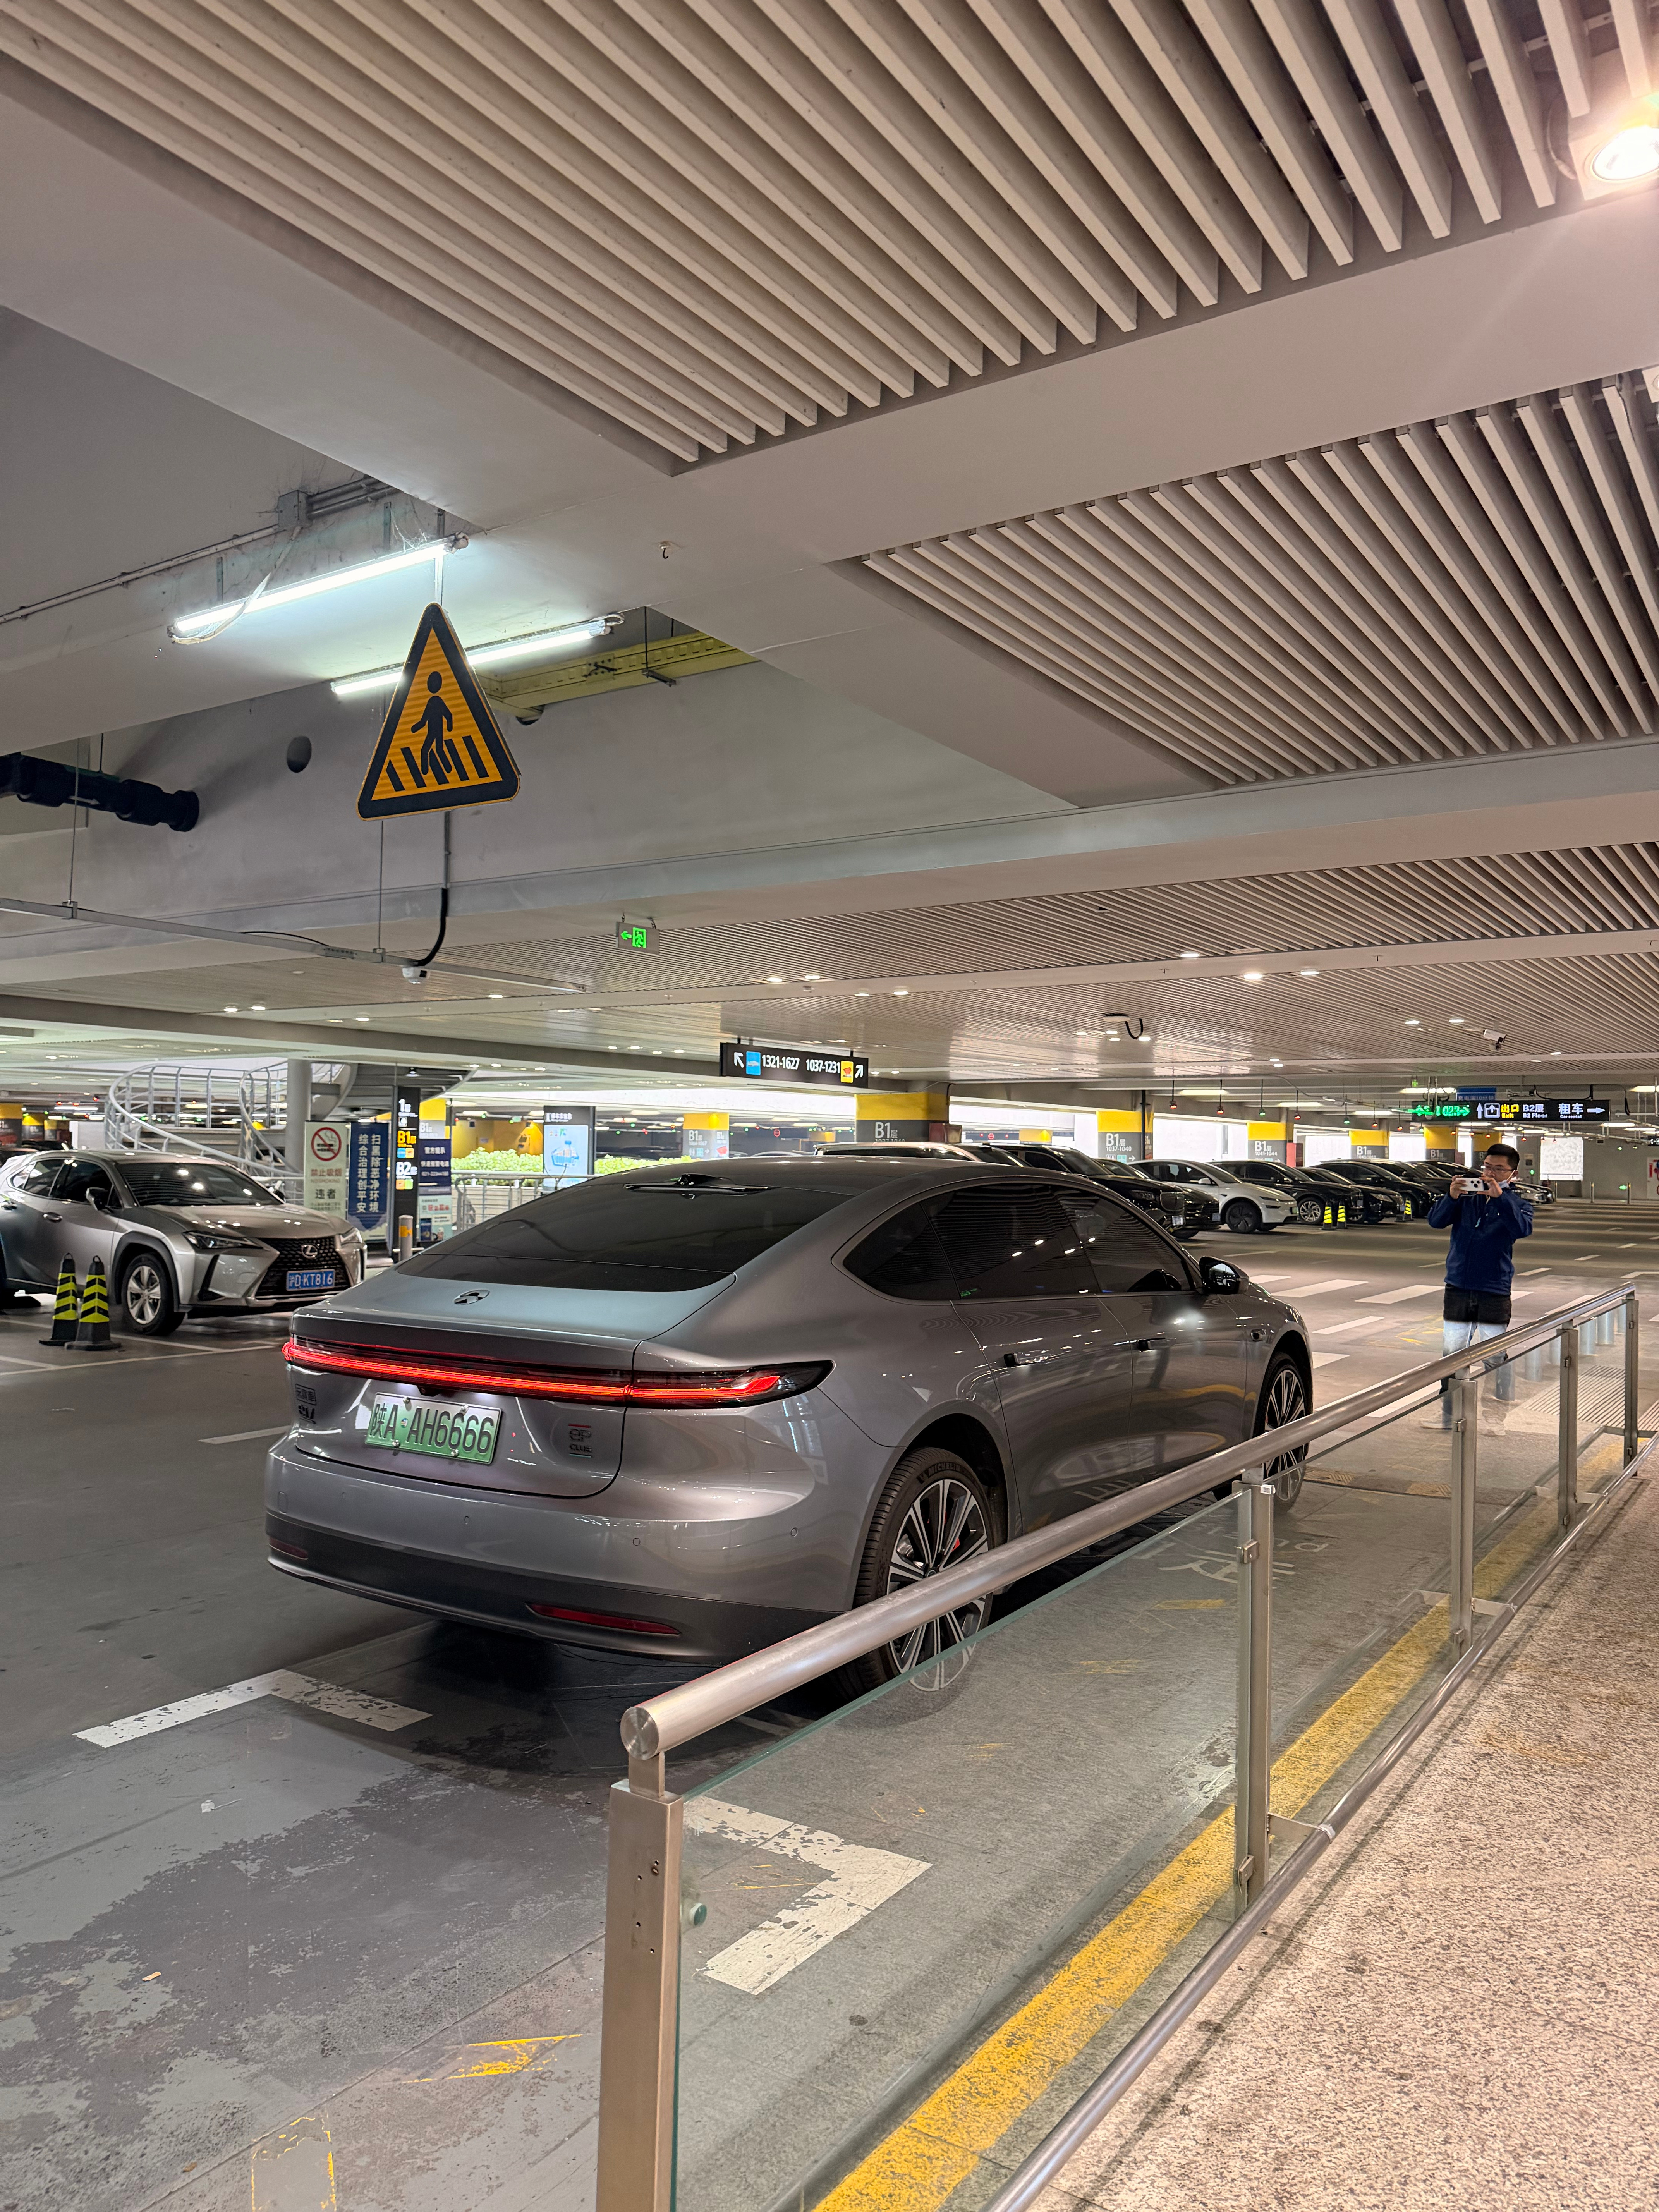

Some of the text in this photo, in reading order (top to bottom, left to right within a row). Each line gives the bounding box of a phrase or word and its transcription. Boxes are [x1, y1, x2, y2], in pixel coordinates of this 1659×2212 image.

[762, 1054, 840, 1073] 1321-1627 1037-1231
[1501, 1104, 1544, 1113] 出口 B2层
[1558, 1103, 1583, 1115] 租车
[875, 1122, 898, 1138] B1层
[1106, 1133, 1125, 1146] B1层
[1255, 1141, 1272, 1151] B1层
[357, 1134, 369, 1213] 综合治理创平安
[369, 1134, 381, 1213] 扫黑除恶净环境
[315, 1189, 336, 1199] 违者
[928, 1462, 961, 1477] MICHELIN
